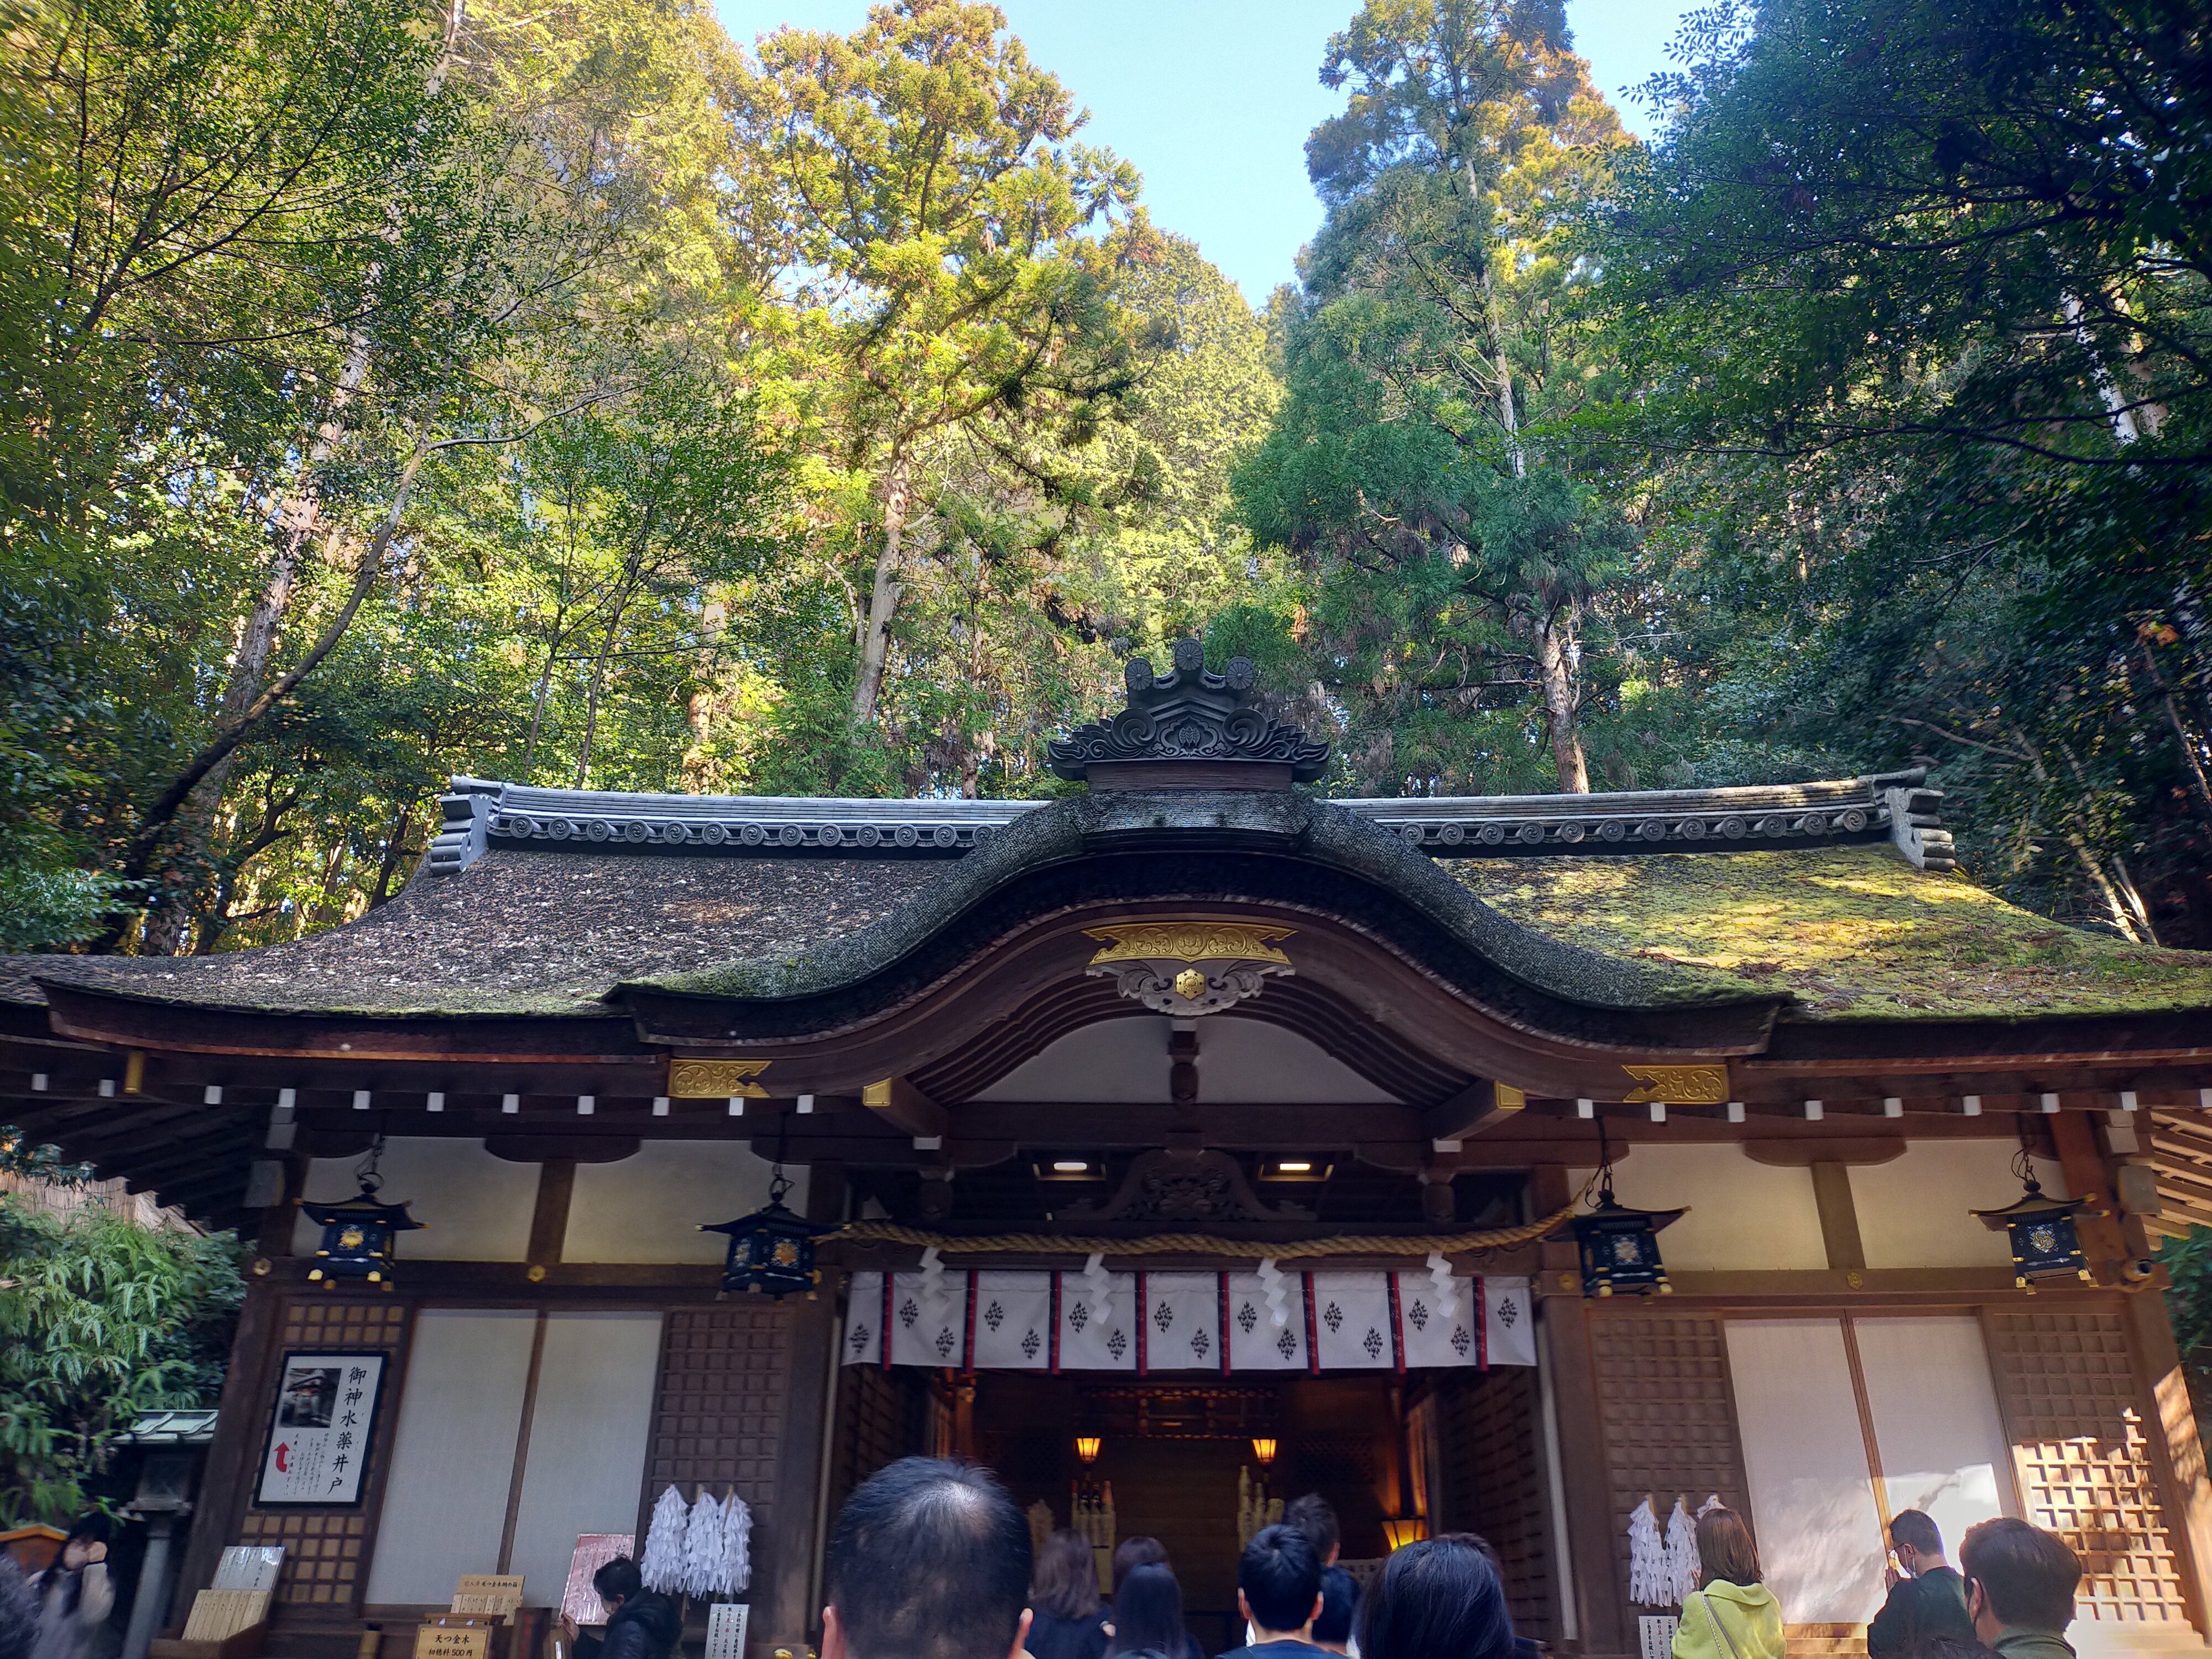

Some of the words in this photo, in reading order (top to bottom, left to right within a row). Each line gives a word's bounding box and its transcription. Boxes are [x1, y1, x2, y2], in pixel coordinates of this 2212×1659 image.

[327, 1366, 367, 1495] 御神水薬井戸
[435, 1634, 470, 1645] 天つ金木
